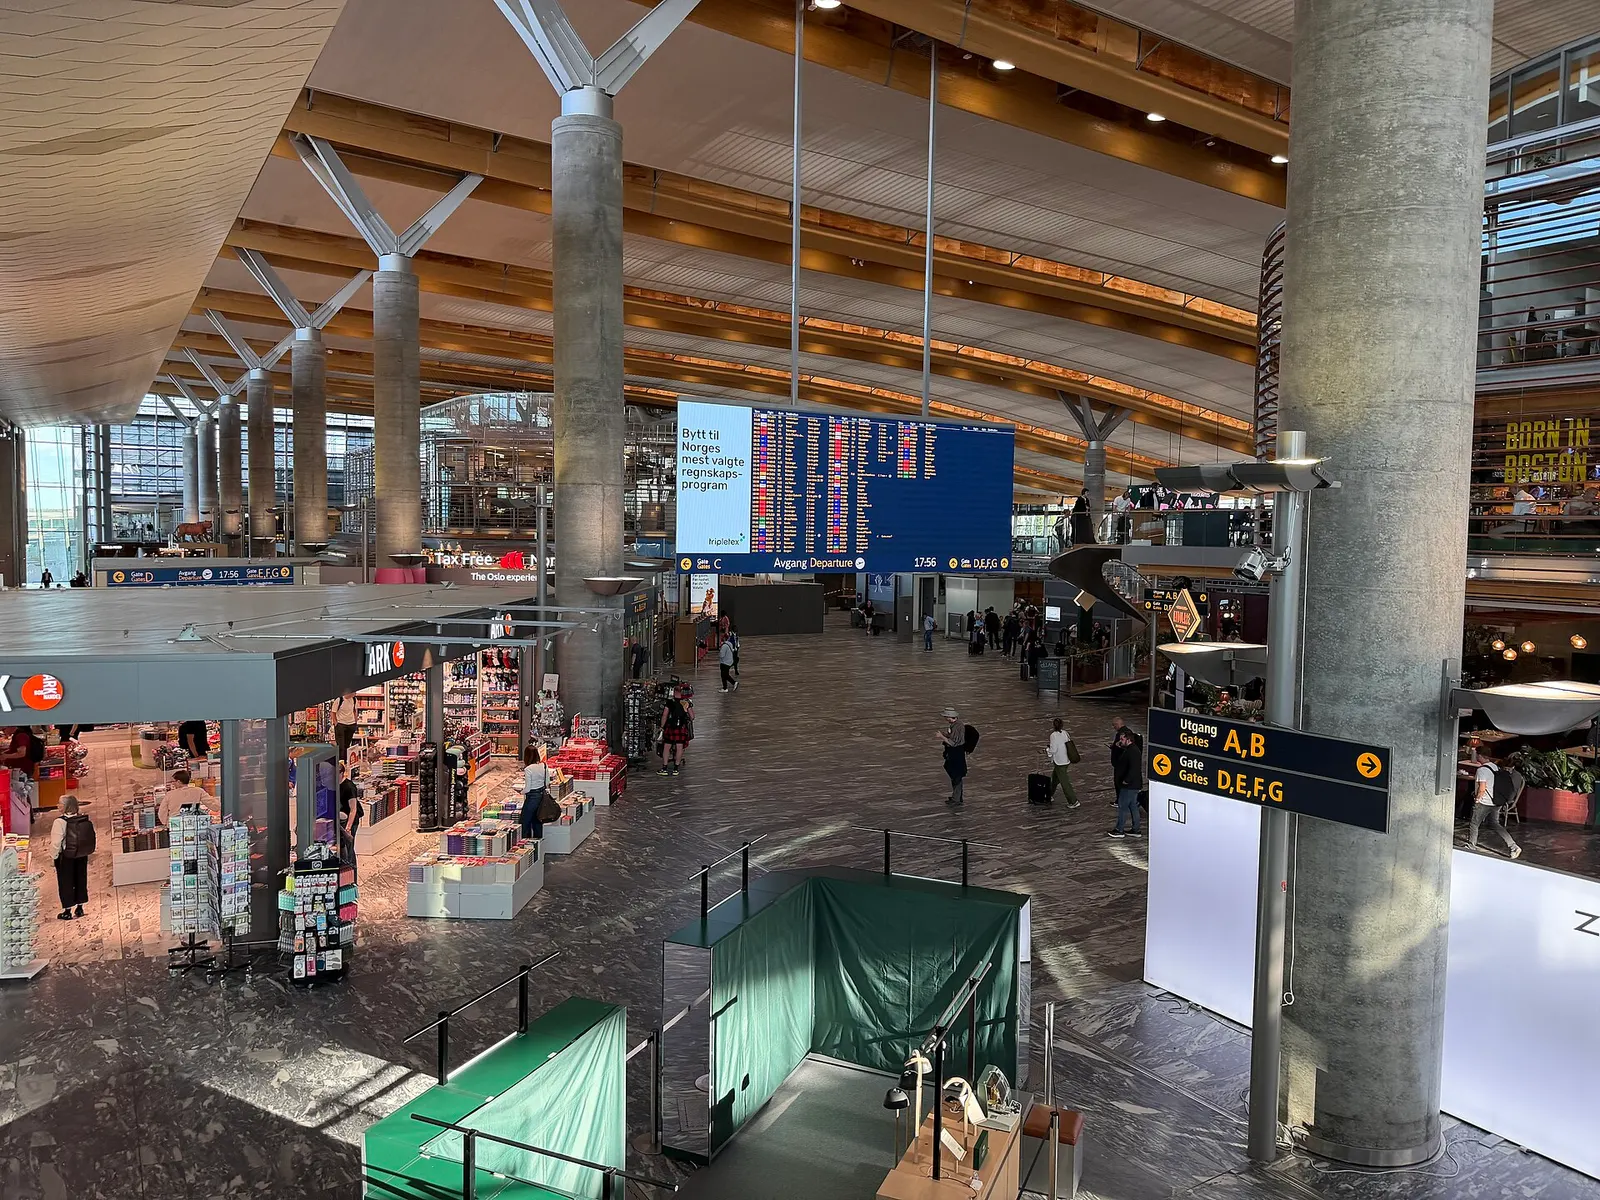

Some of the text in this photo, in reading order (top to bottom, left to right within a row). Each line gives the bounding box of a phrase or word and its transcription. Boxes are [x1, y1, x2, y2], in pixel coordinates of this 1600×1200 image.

[682, 428, 720, 440] Bytt til
[1506, 418, 1590, 450] BORN IN
[682, 442, 721, 454] Norges
[682, 454, 745, 468] mest valgte
[682, 468, 742, 480] regnskaps-
[1504, 452, 1588, 484] BOSTON
[681, 480, 728, 492] program
[708, 537, 740, 547] tripletex
[434, 552, 458, 565] Tax
[462, 553, 492, 566] Free
[714, 558, 722, 570] C
[774, 558, 853, 570] Avgang Departure
[914, 557, 936, 568] 17:56
[974, 558, 998, 570] D,E,F,G
[146, 572, 154, 582] D
[258, 568, 279, 579] E,F,G
[470, 572, 486, 580] The
[487, 572, 505, 581] Oslo
[368, 642, 392, 676] ARK
[42, 674, 57, 694] ARK
[1180, 718, 1218, 738] Utgang
[1180, 732, 1209, 748] Gates
[1223, 729, 1266, 759] A,B
[1180, 756, 1204, 771] Gate
[1179, 770, 1209, 786] Gates
[1216, 769, 1284, 802] D,E,F,G
